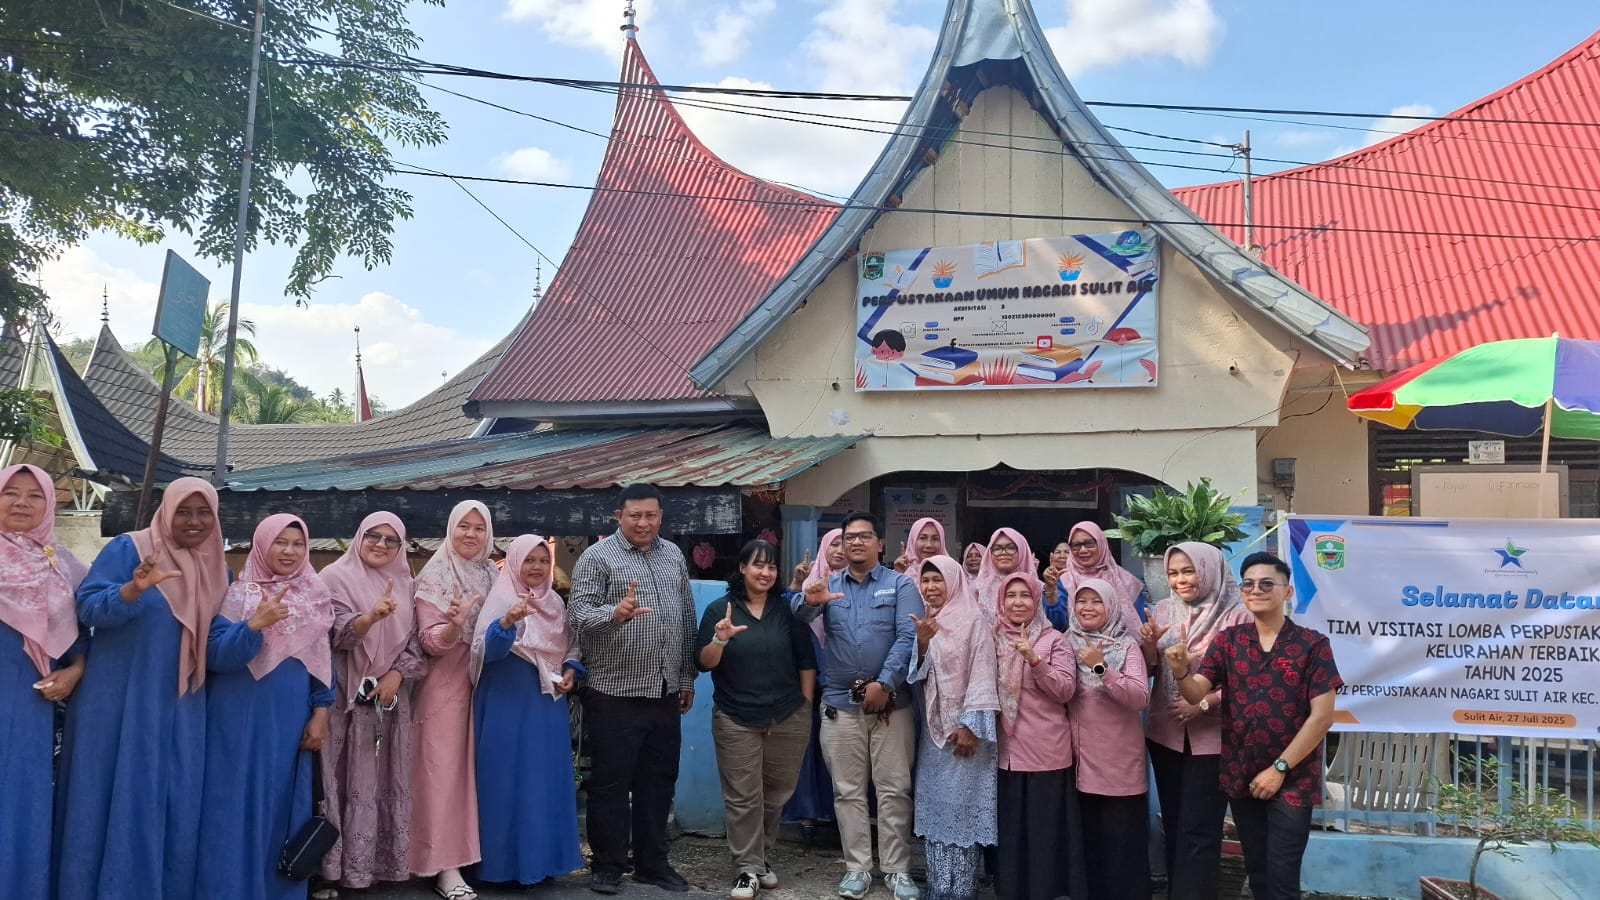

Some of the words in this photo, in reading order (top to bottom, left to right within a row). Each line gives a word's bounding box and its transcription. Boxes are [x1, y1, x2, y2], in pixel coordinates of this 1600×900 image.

[862, 290, 974, 307] PERPUSTAKAAN
[976, 286, 1019, 301] UMUM
[1022, 284, 1077, 299] NAGARI
[1080, 280, 1123, 296] SULIT
[1126, 279, 1153, 294] AIR
[1401, 585, 1518, 609] Selamat
[1327, 619, 1361, 635] TIM
[1368, 621, 1443, 638] VISITASI
[1448, 623, 1505, 639] LOMBA
[1510, 624, 1600, 641] PERPUSTAK
[1426, 643, 1525, 660] KELURAHAN
[1530, 645, 1600, 663] TERBAIK
[1465, 665, 1515, 681] TAHUN
[1521, 666, 1563, 683] 2025
[1335, 685, 1349, 695] DI
[1352, 684, 1447, 698] PERPUSTAKAAN
[1451, 687, 1500, 701] NAGARI
[1504, 689, 1538, 702] SULIT
[1543, 691, 1568, 704] AIR
[1572, 692, 1599, 705] KEC.
[1464, 712, 1485, 722] Sulit
[1488, 713, 1505, 723] Air,
[1507, 714, 1519, 723] 27
[1521, 714, 1539, 723] Juli
[1542, 715, 1565, 725] 2025
